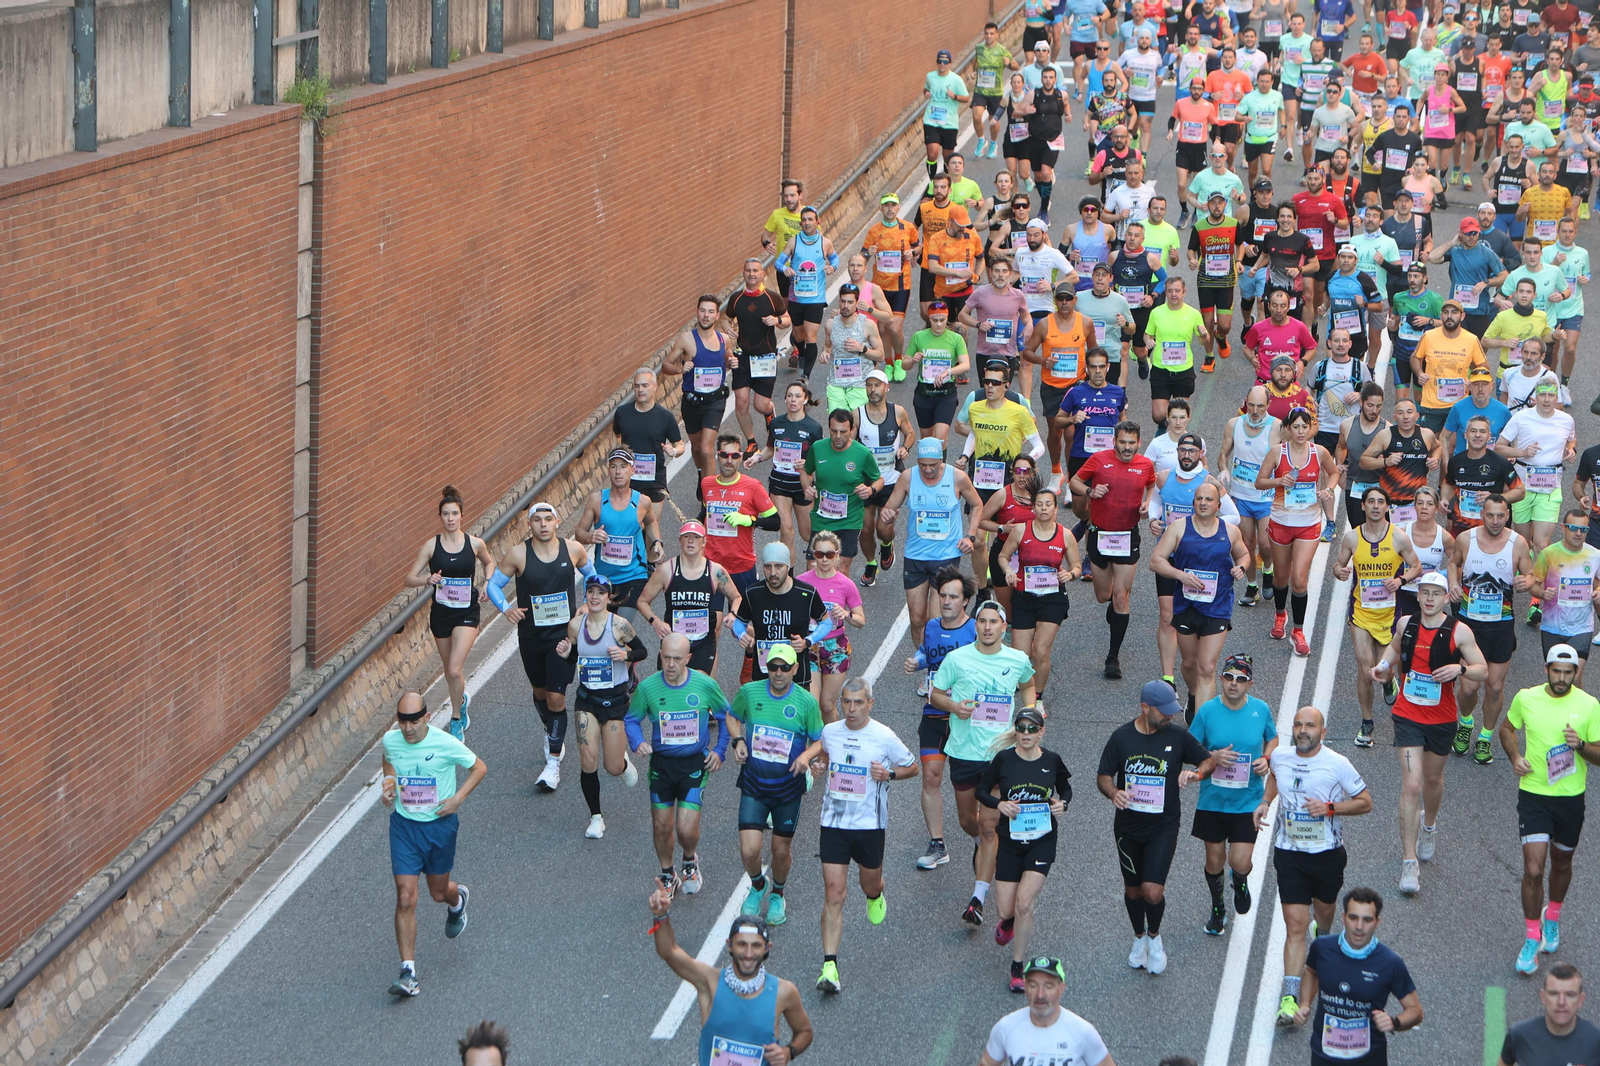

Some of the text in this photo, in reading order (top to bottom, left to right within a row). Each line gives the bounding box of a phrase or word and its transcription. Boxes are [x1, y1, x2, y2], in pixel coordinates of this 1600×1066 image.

[974, 422, 1007, 432] TRIBOOST
[1241, 461, 1257, 469] ZURICH
[1358, 562, 1393, 572] TANINOS
[671, 591, 710, 602] ENTIRE
[767, 730, 789, 739] ZURICH
[1551, 744, 1569, 756] ZURICH
[841, 766, 862, 774] ZURICH
[1321, 990, 1372, 1010] Siente lo que
[1322, 1003, 1366, 1018] nos mueve
[730, 1044, 756, 1056] ZURICH
